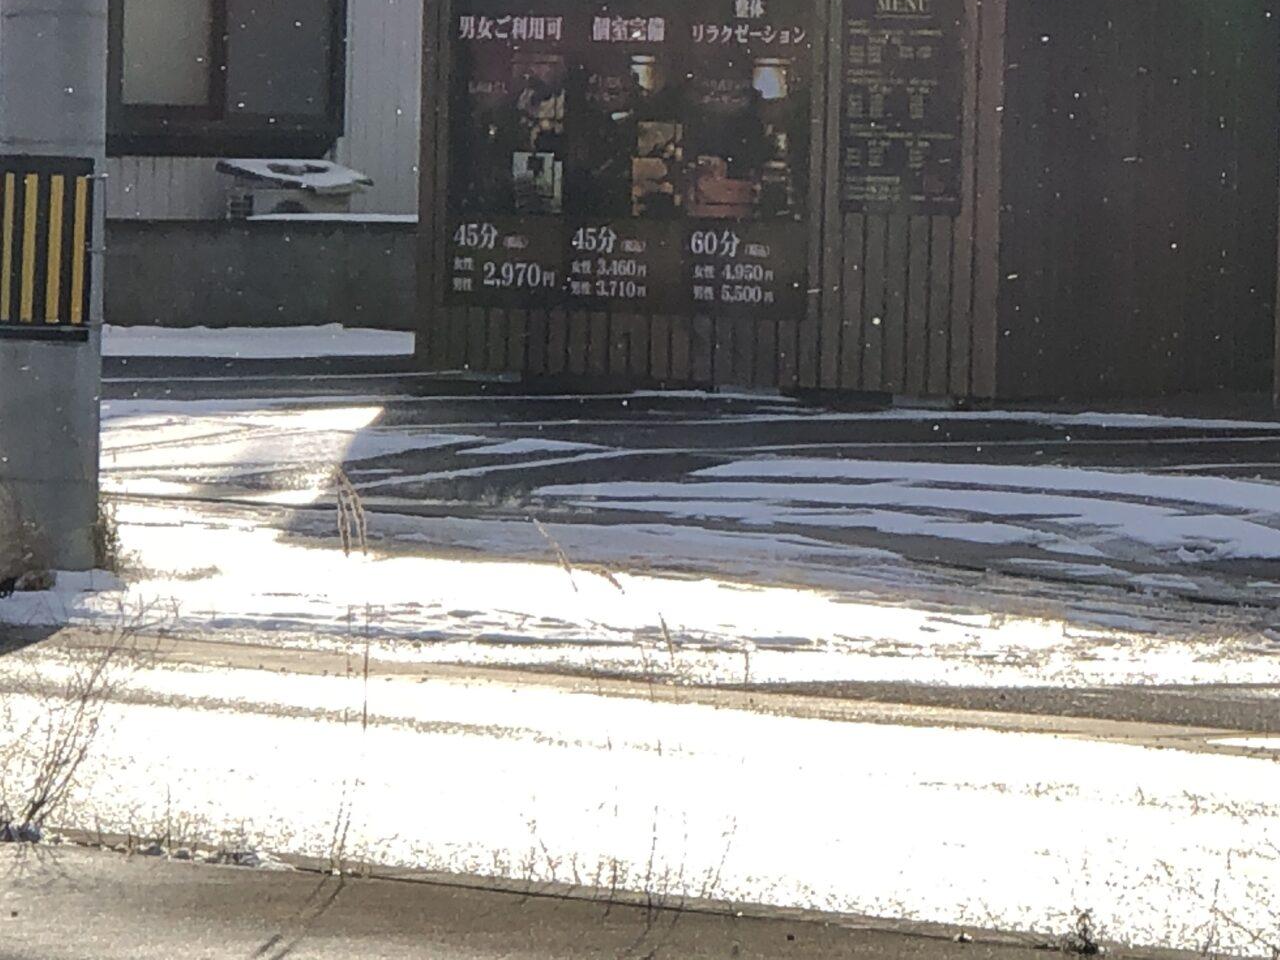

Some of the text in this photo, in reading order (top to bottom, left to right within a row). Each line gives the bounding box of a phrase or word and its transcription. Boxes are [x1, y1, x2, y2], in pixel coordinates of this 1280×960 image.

[459, 14, 563, 40] 男女ご利用可
[692, 24, 806, 44] リラクゼーション
[453, 222, 499, 250] 45分
[571, 226, 618, 254] 45分
[690, 230, 742, 258] 60分
[483, 261, 556, 287] 2,970円
